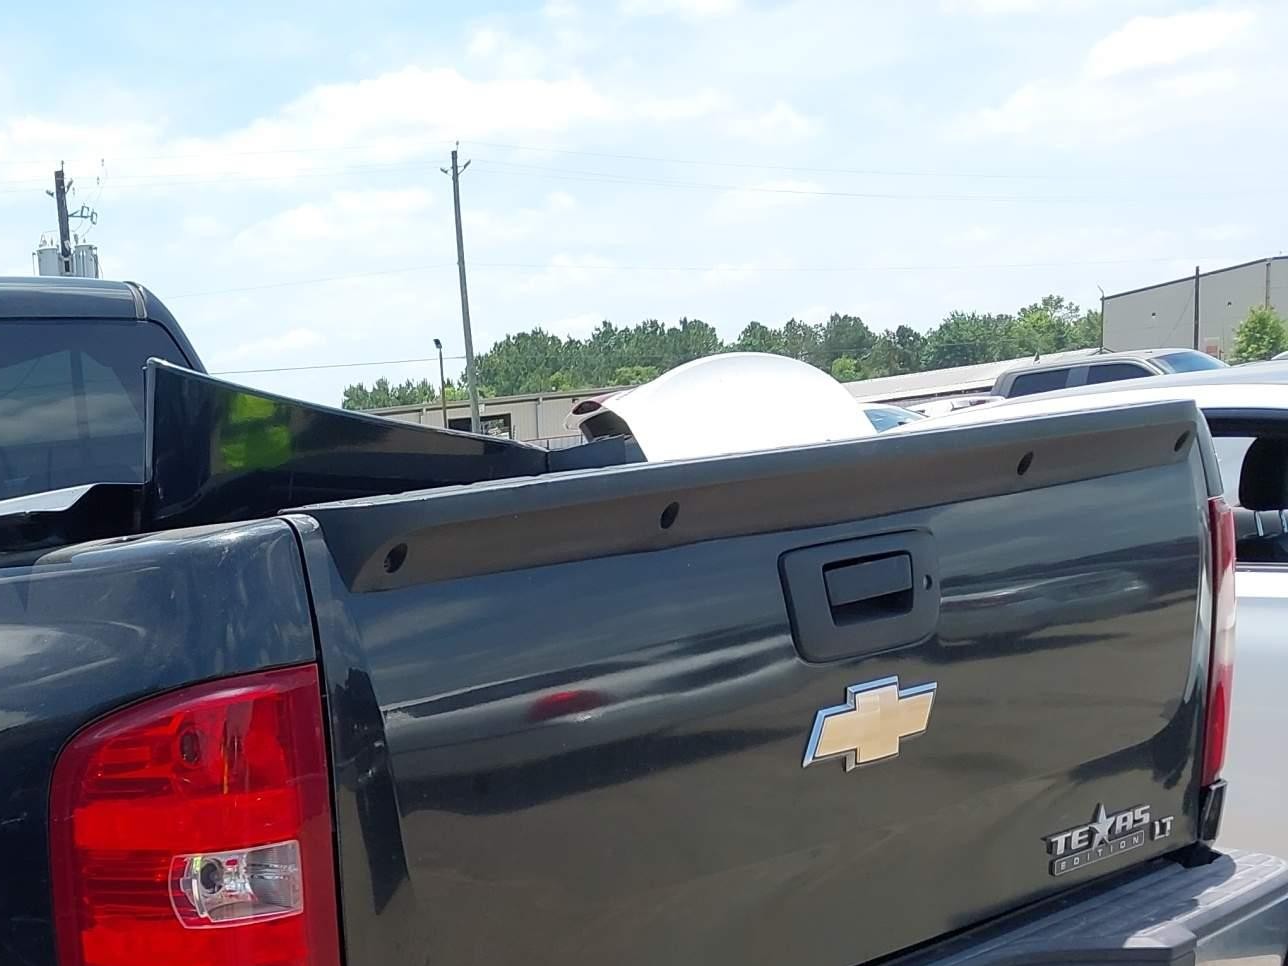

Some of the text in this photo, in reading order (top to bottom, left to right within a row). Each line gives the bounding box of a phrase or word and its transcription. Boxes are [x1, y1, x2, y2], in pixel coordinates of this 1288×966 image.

[1050, 803, 1151, 855] TEXAS
[1153, 816, 1174, 840] LT
[1059, 836, 1140, 870] EDITION
